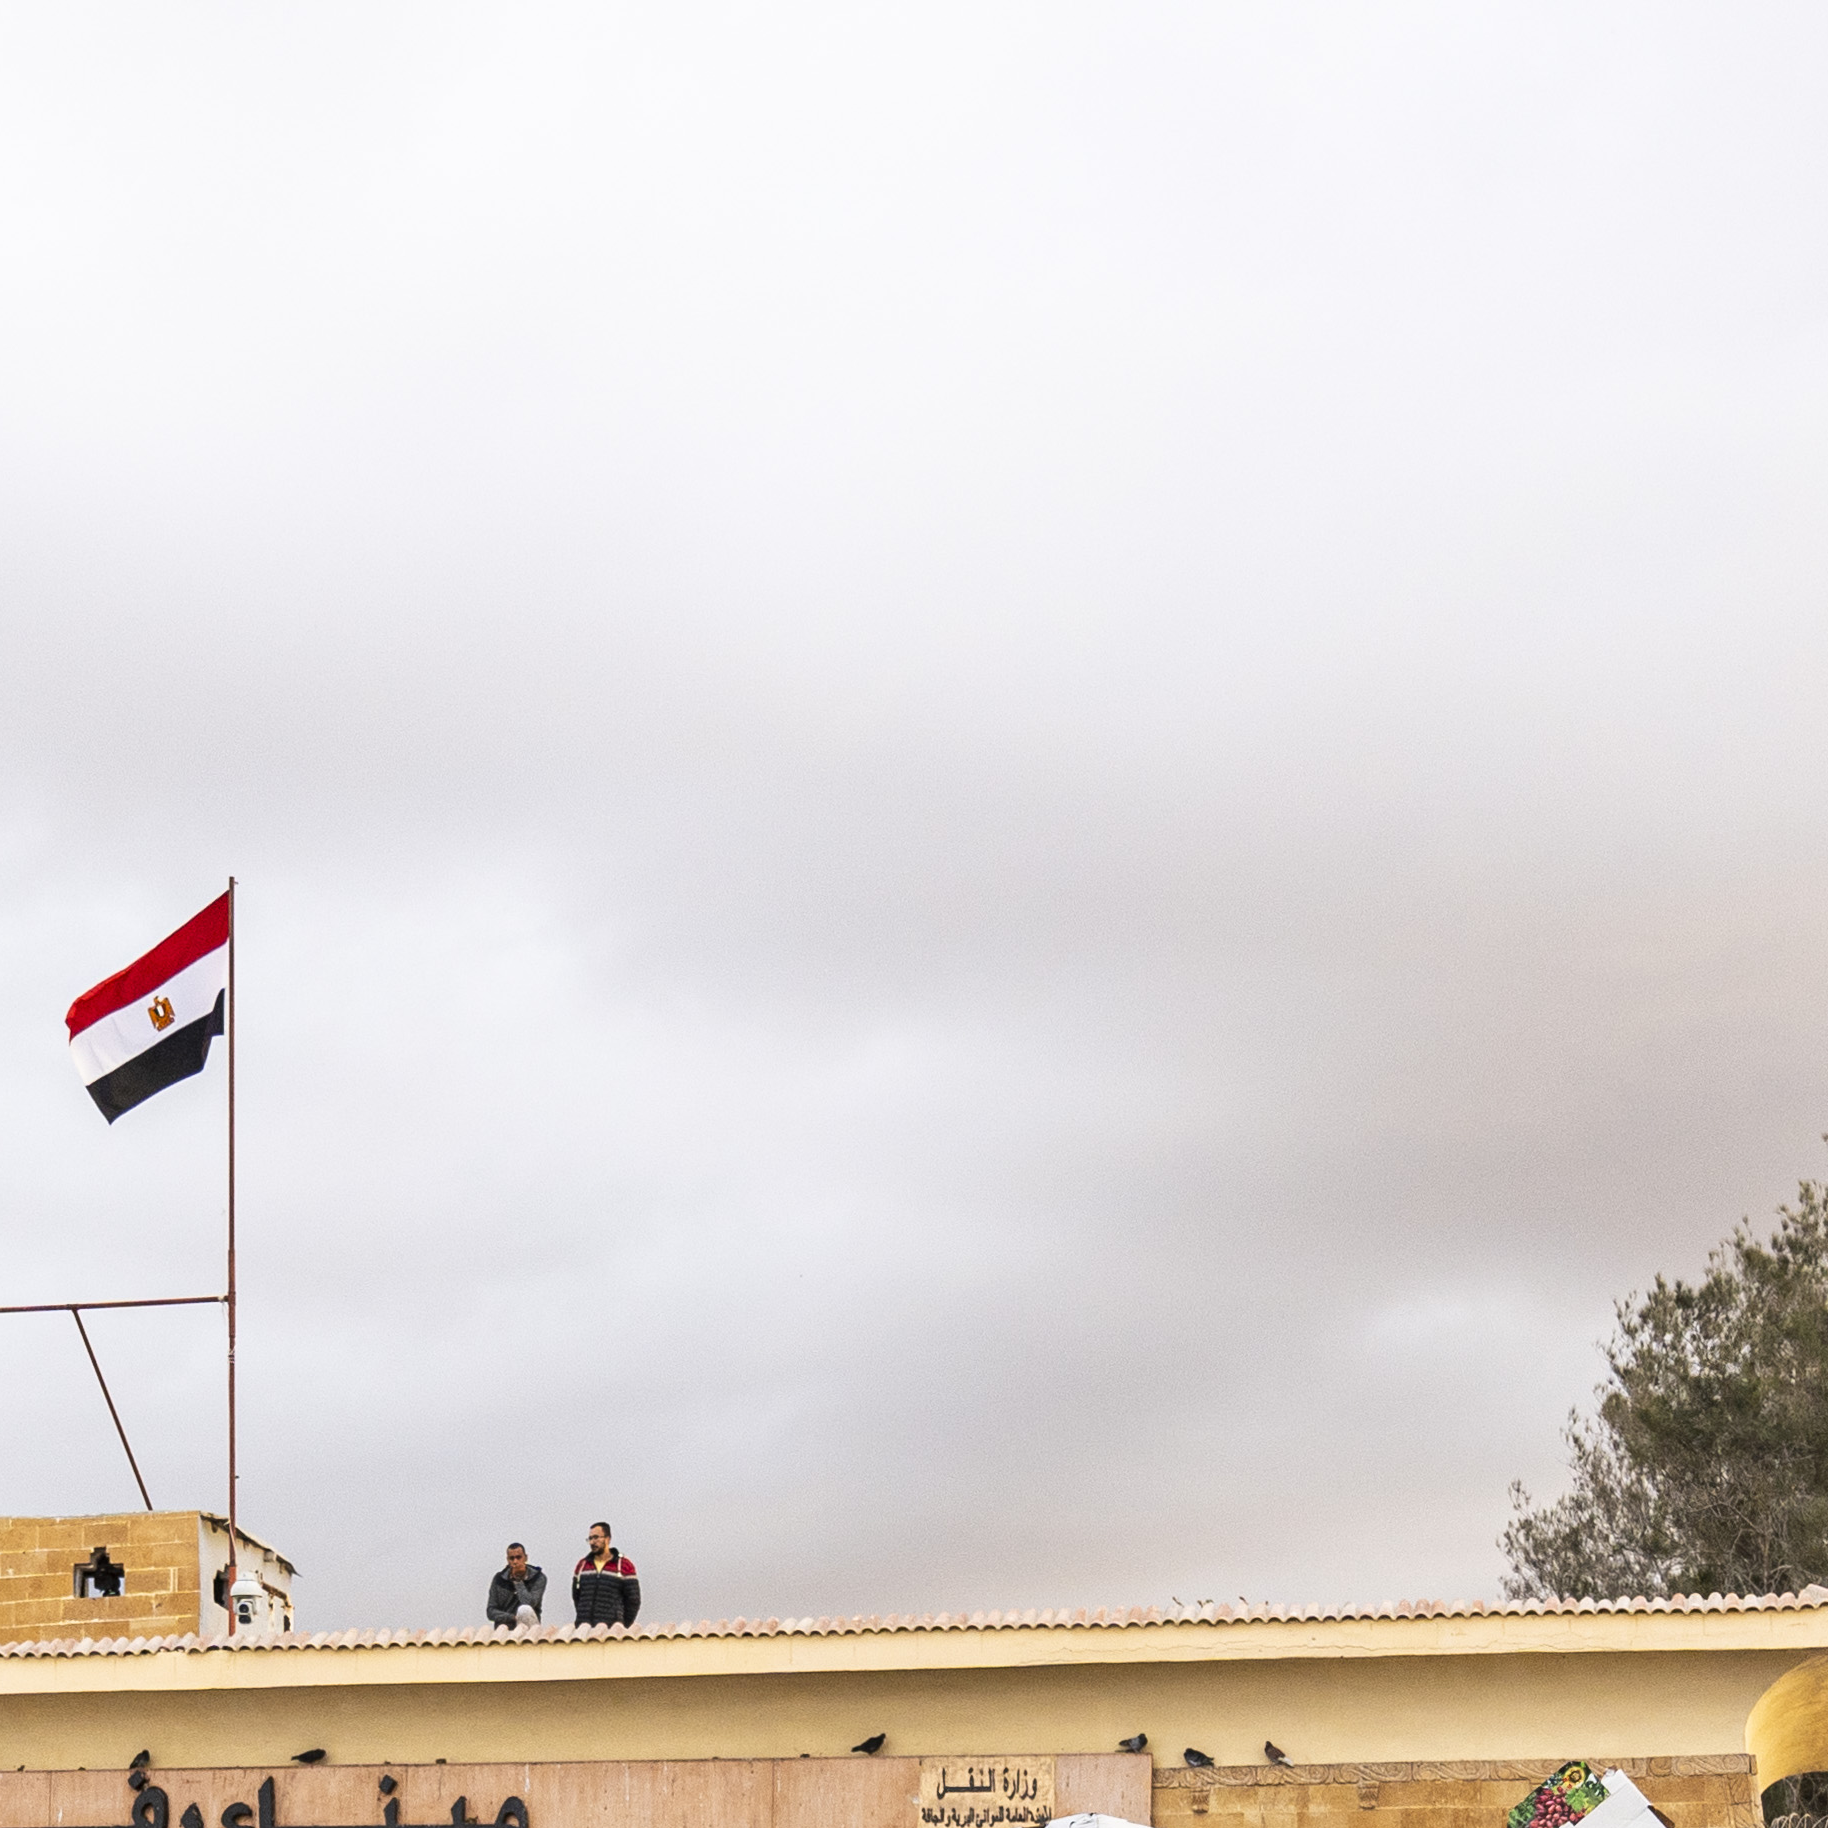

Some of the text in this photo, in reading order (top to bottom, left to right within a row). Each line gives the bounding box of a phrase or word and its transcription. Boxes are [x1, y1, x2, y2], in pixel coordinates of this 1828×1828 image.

[937, 1767, 1037, 1800] وزارة النقل
[1006, 1807, 1028, 1823] العامة
